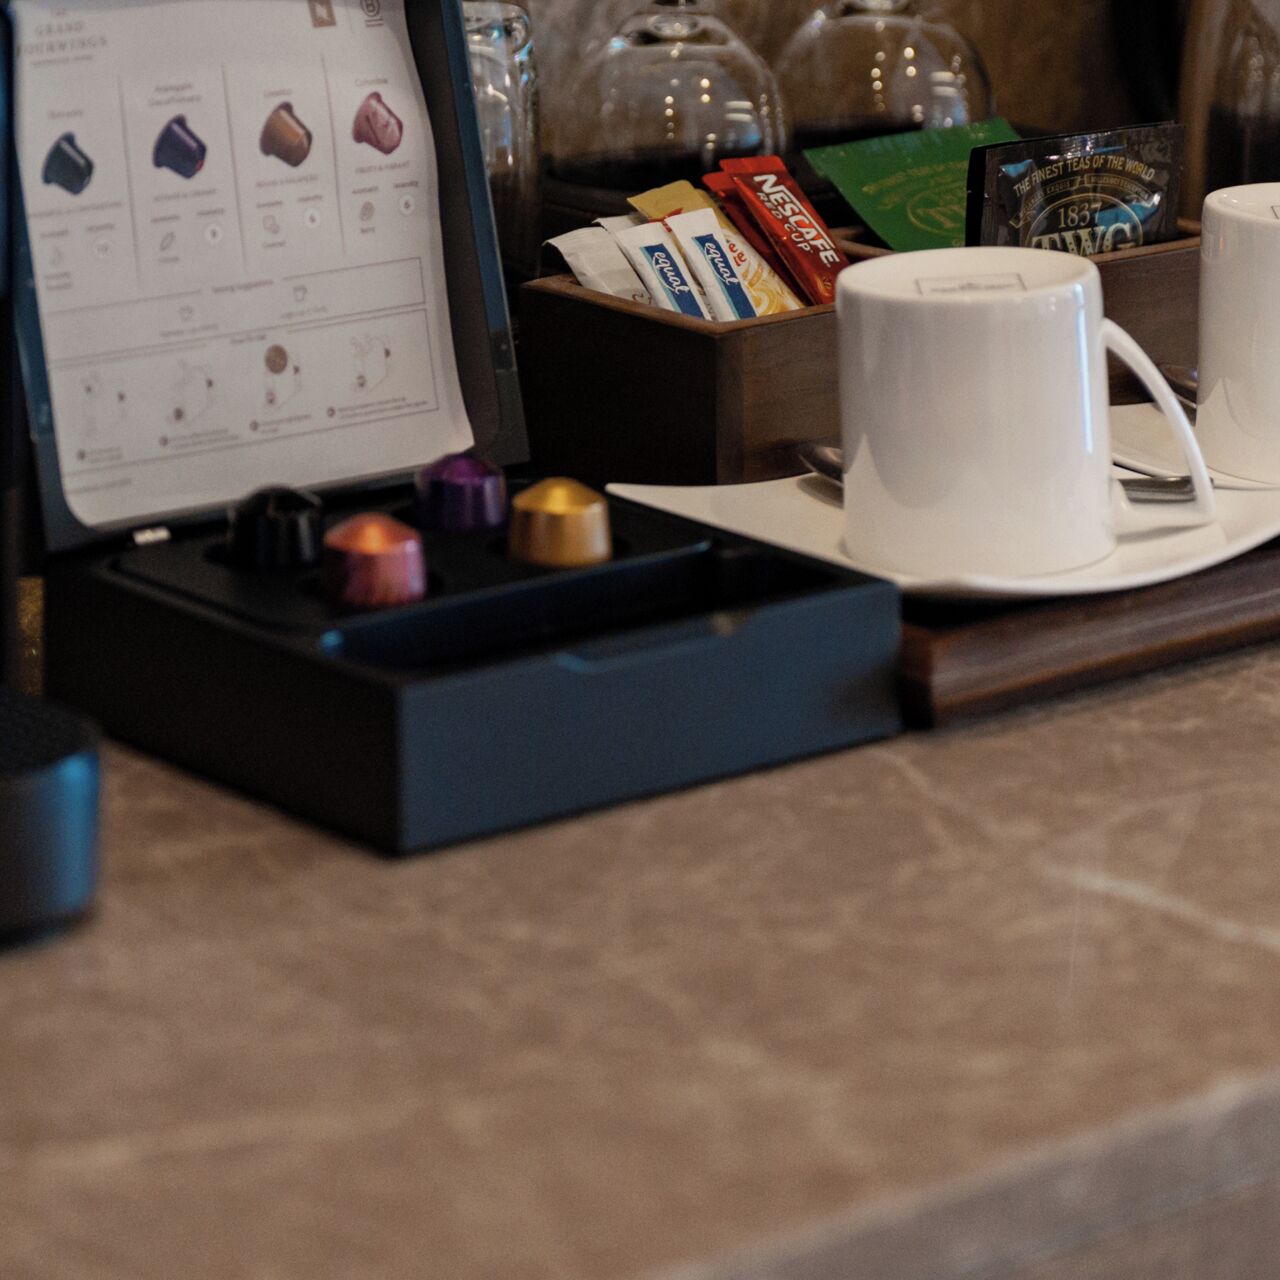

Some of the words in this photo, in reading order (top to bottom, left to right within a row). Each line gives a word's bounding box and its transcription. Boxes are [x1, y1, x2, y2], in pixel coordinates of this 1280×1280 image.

[1013, 180, 1030, 197] THE
[1031, 162, 1064, 185] FINEST
[1066, 157, 1091, 173] TEAS
[1092, 155, 1104, 167] OF
[1107, 155, 1125, 170] THE
[1125, 158, 1156, 182] WORLD
[756, 192, 783, 220] RED
[784, 223, 812, 252] CUP
[1058, 201, 1103, 229] 1837
[653, 251, 692, 296] equal
[704, 241, 741, 287] equal
